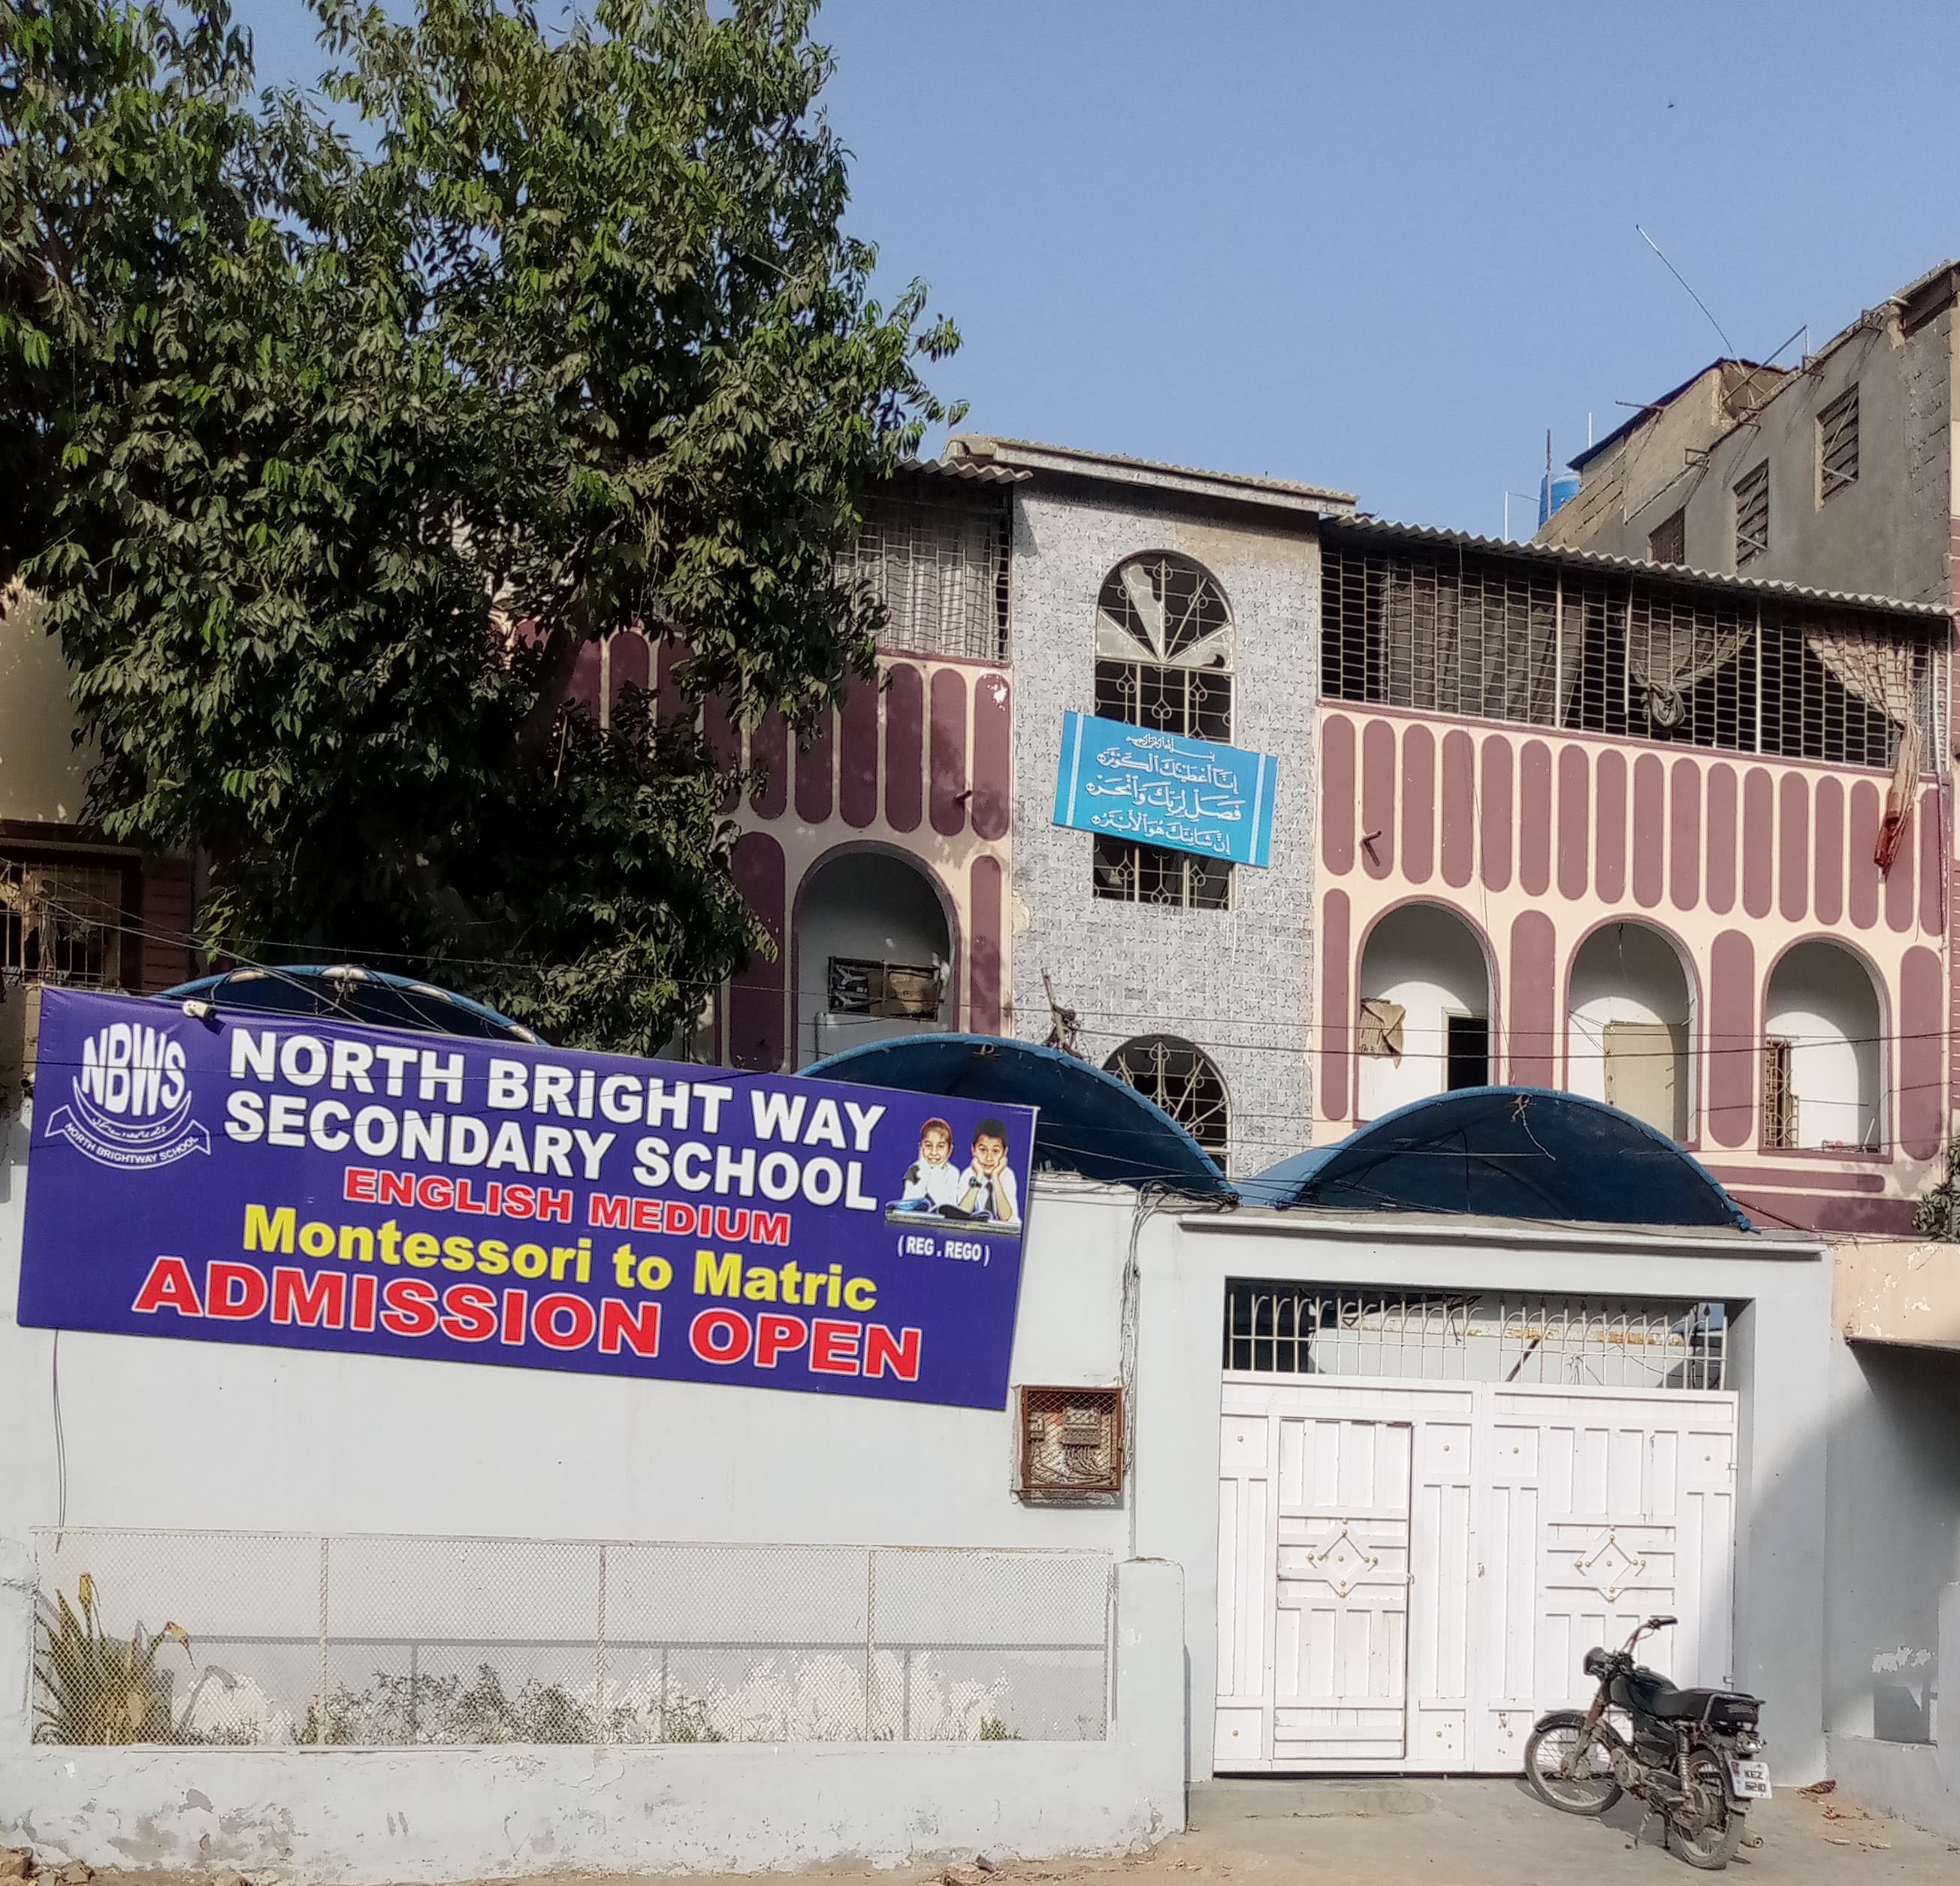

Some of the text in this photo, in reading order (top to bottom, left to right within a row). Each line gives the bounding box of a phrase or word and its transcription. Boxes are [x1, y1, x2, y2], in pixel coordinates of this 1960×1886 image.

[81, 1022, 188, 1116] NBWS
[230, 1027, 886, 1151] NORTH BRIGHT WAY
[65, 1122, 96, 1151] NORTH
[96, 1145, 157, 1164] BRIGHTWAY
[159, 1136, 199, 1160] SCHOOL
[225, 1090, 878, 1212] SECONDARY SCHOOL
[243, 1203, 877, 1311] Montessori to Matric
[343, 1166, 791, 1247] ENGLISH MEDIUM
[132, 1256, 923, 1382] ADMISSION OPEN
